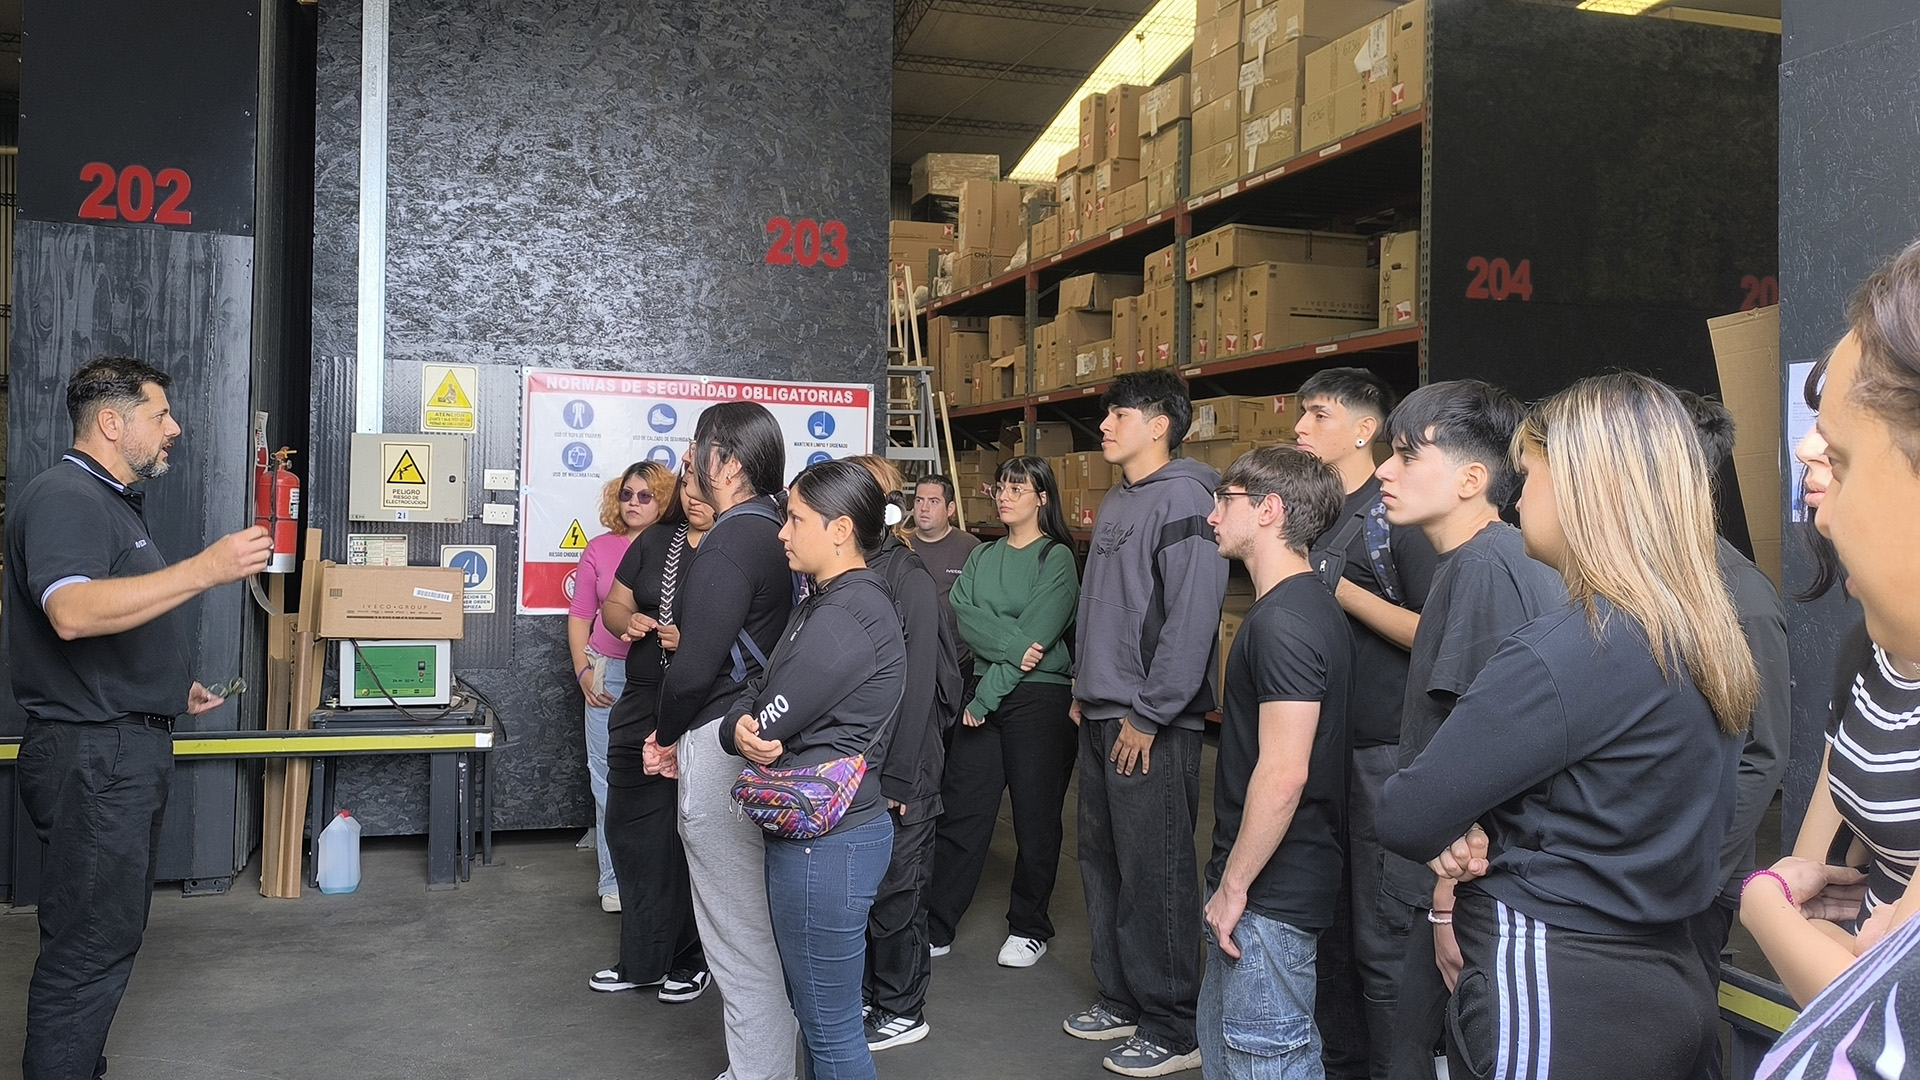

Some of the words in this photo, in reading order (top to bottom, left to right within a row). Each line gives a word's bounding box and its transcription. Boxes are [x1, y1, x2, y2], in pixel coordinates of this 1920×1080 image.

[77, 162, 192, 225] 202
[764, 214, 849, 268] 203
[1465, 255, 1534, 302] 204
[1740, 274, 1779, 312] 20
[546, 375, 616, 393] NORMAS
[621, 380, 642, 394] DE
[647, 381, 737, 399] SEGURIDAD
[741, 385, 854, 404] OBLIGATORIAS
[755, 694, 790, 736] PRO
